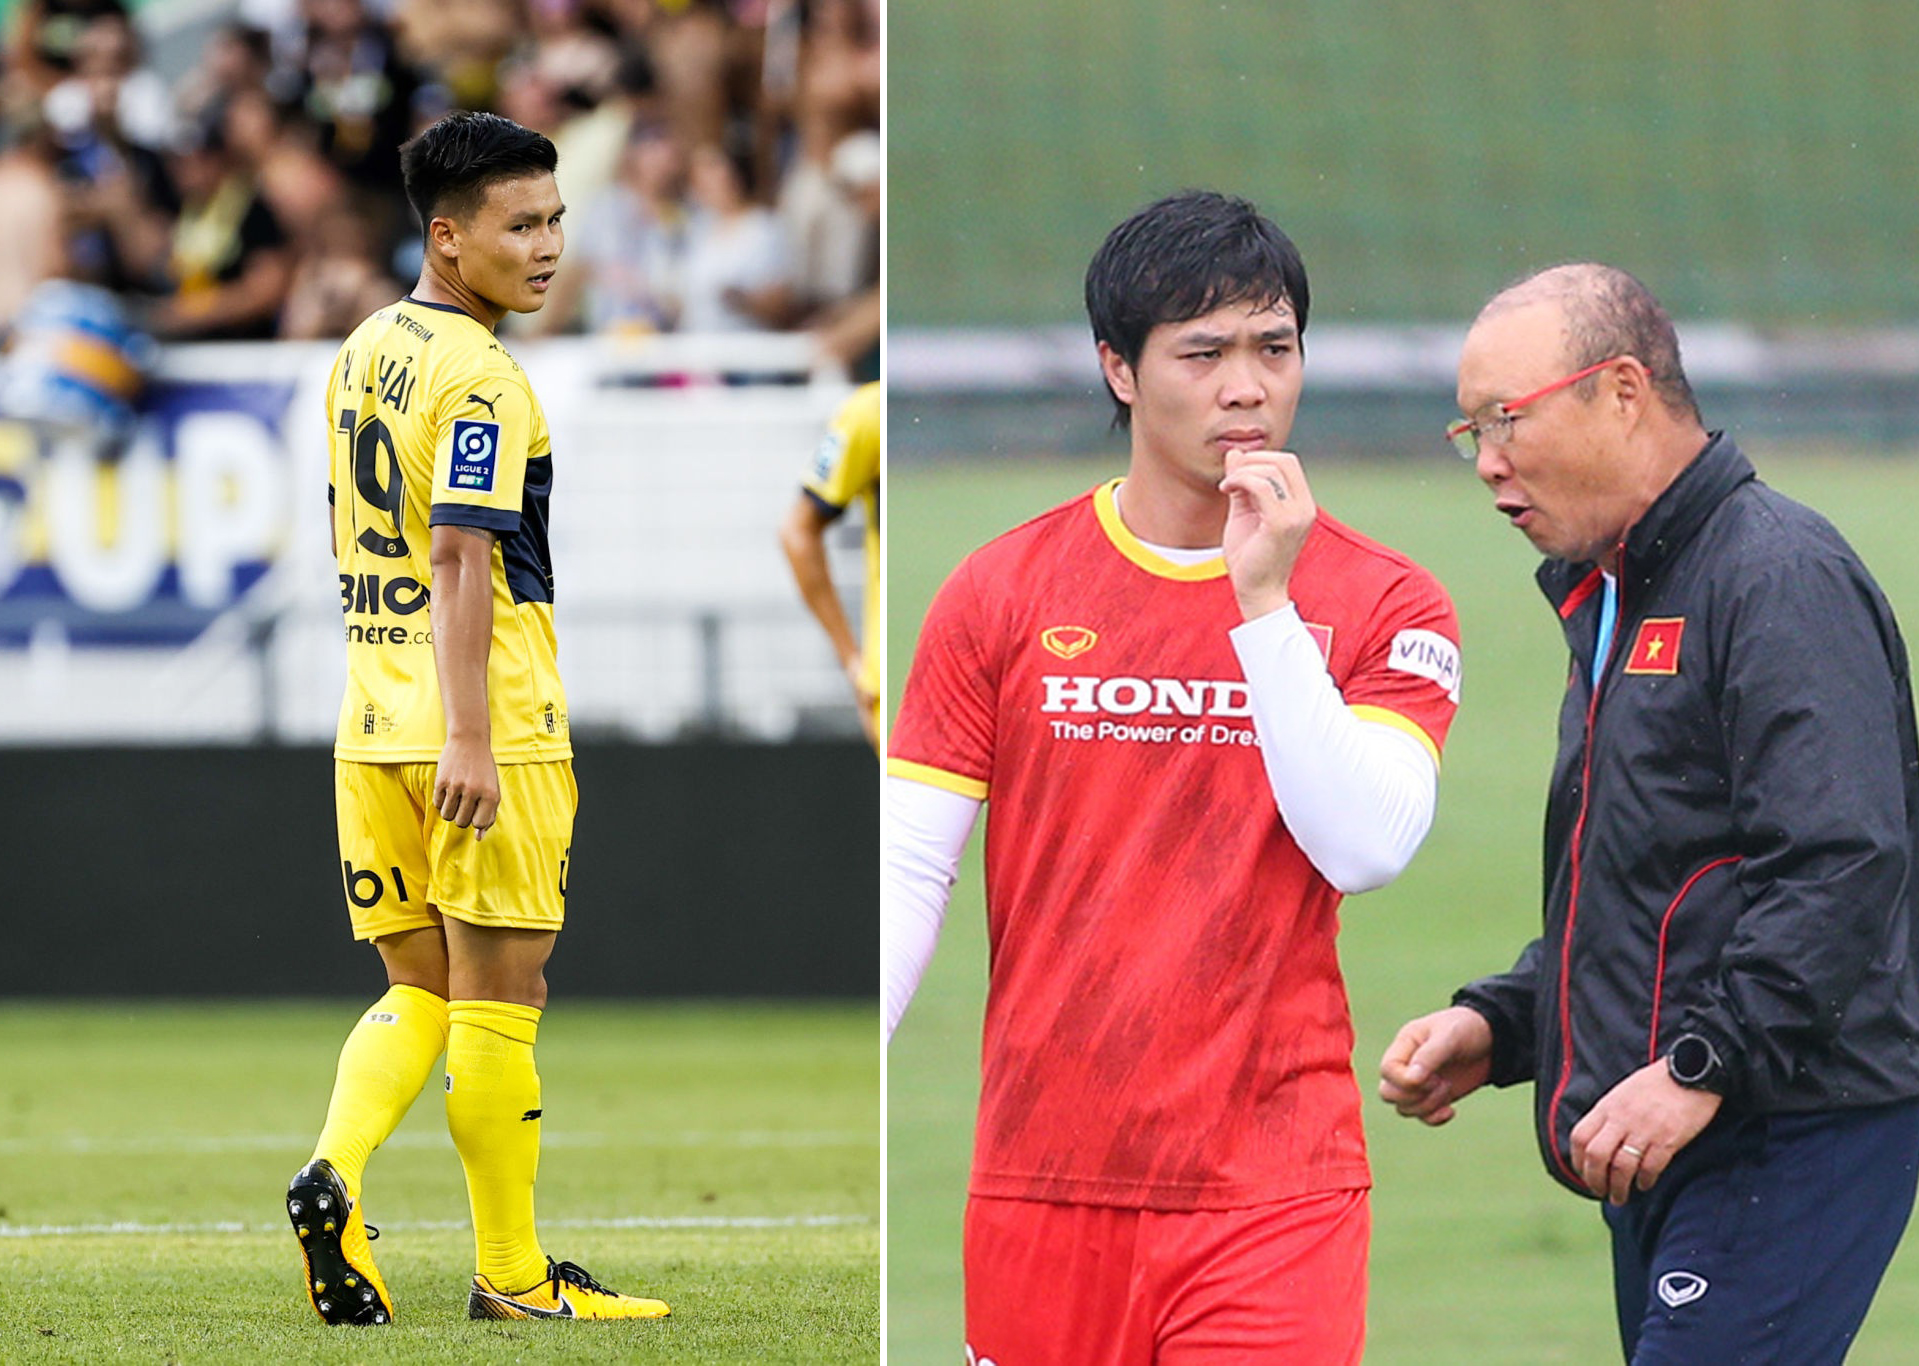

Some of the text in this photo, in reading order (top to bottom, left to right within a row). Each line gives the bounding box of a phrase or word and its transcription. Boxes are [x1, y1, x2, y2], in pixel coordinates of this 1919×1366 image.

[455, 464, 489, 475] LIGUE 2
[337, 408, 412, 559] 19
[1050, 720, 1094, 740] The
[1099, 721, 1176, 743] Power
[1180, 724, 1206, 744] of
